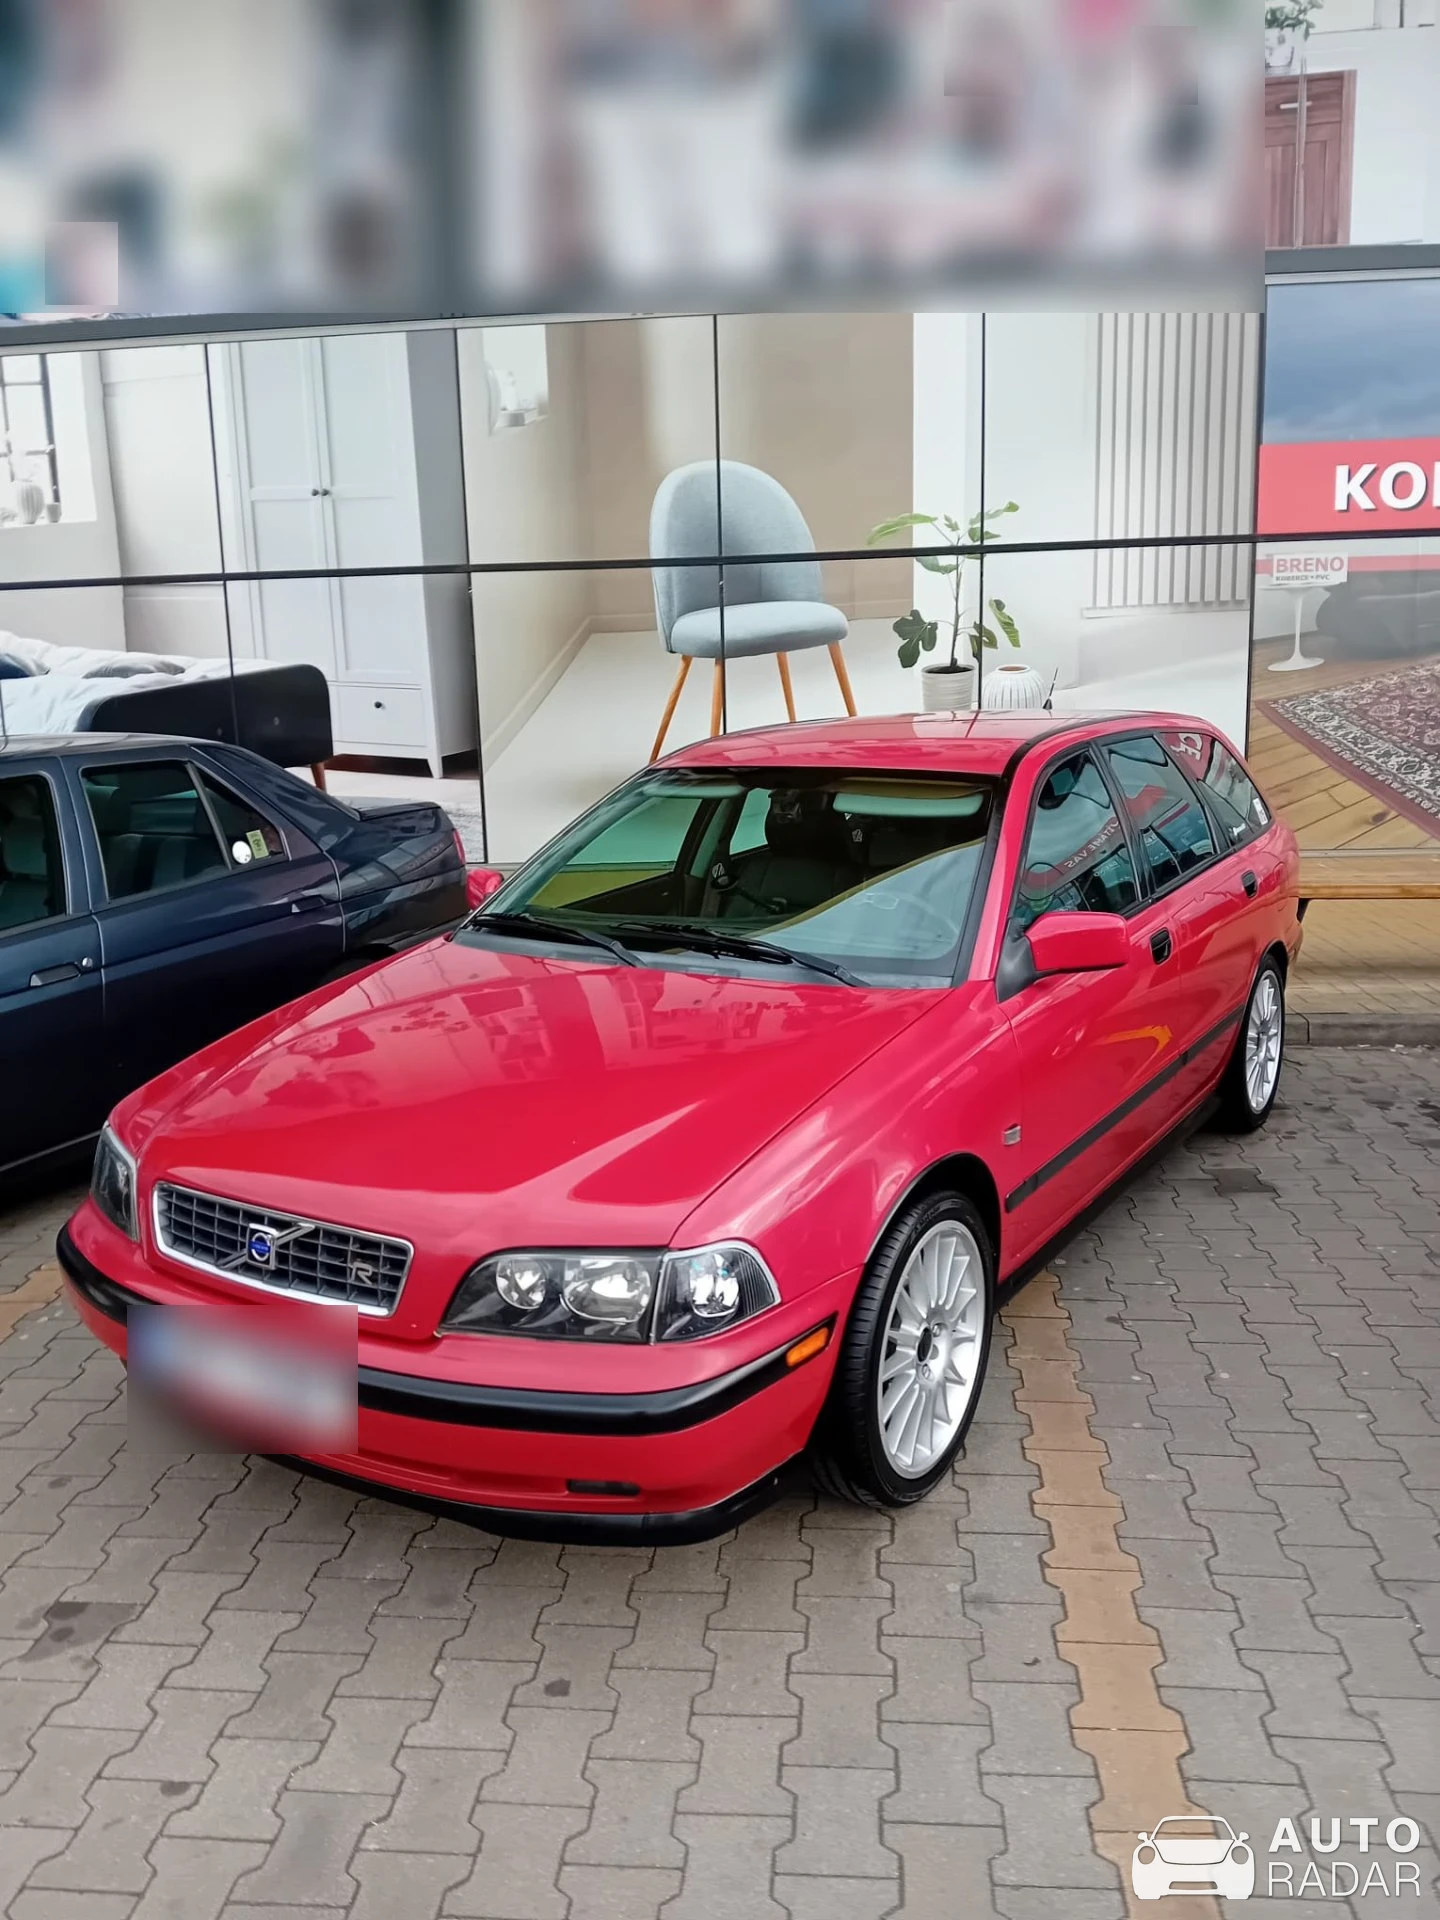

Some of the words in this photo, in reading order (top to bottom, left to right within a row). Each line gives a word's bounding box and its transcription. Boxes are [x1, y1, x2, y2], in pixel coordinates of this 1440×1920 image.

[1334, 461, 1440, 511] KO
[1276, 555, 1345, 573] BRENO
[1314, 573, 1331, 581] PVC
